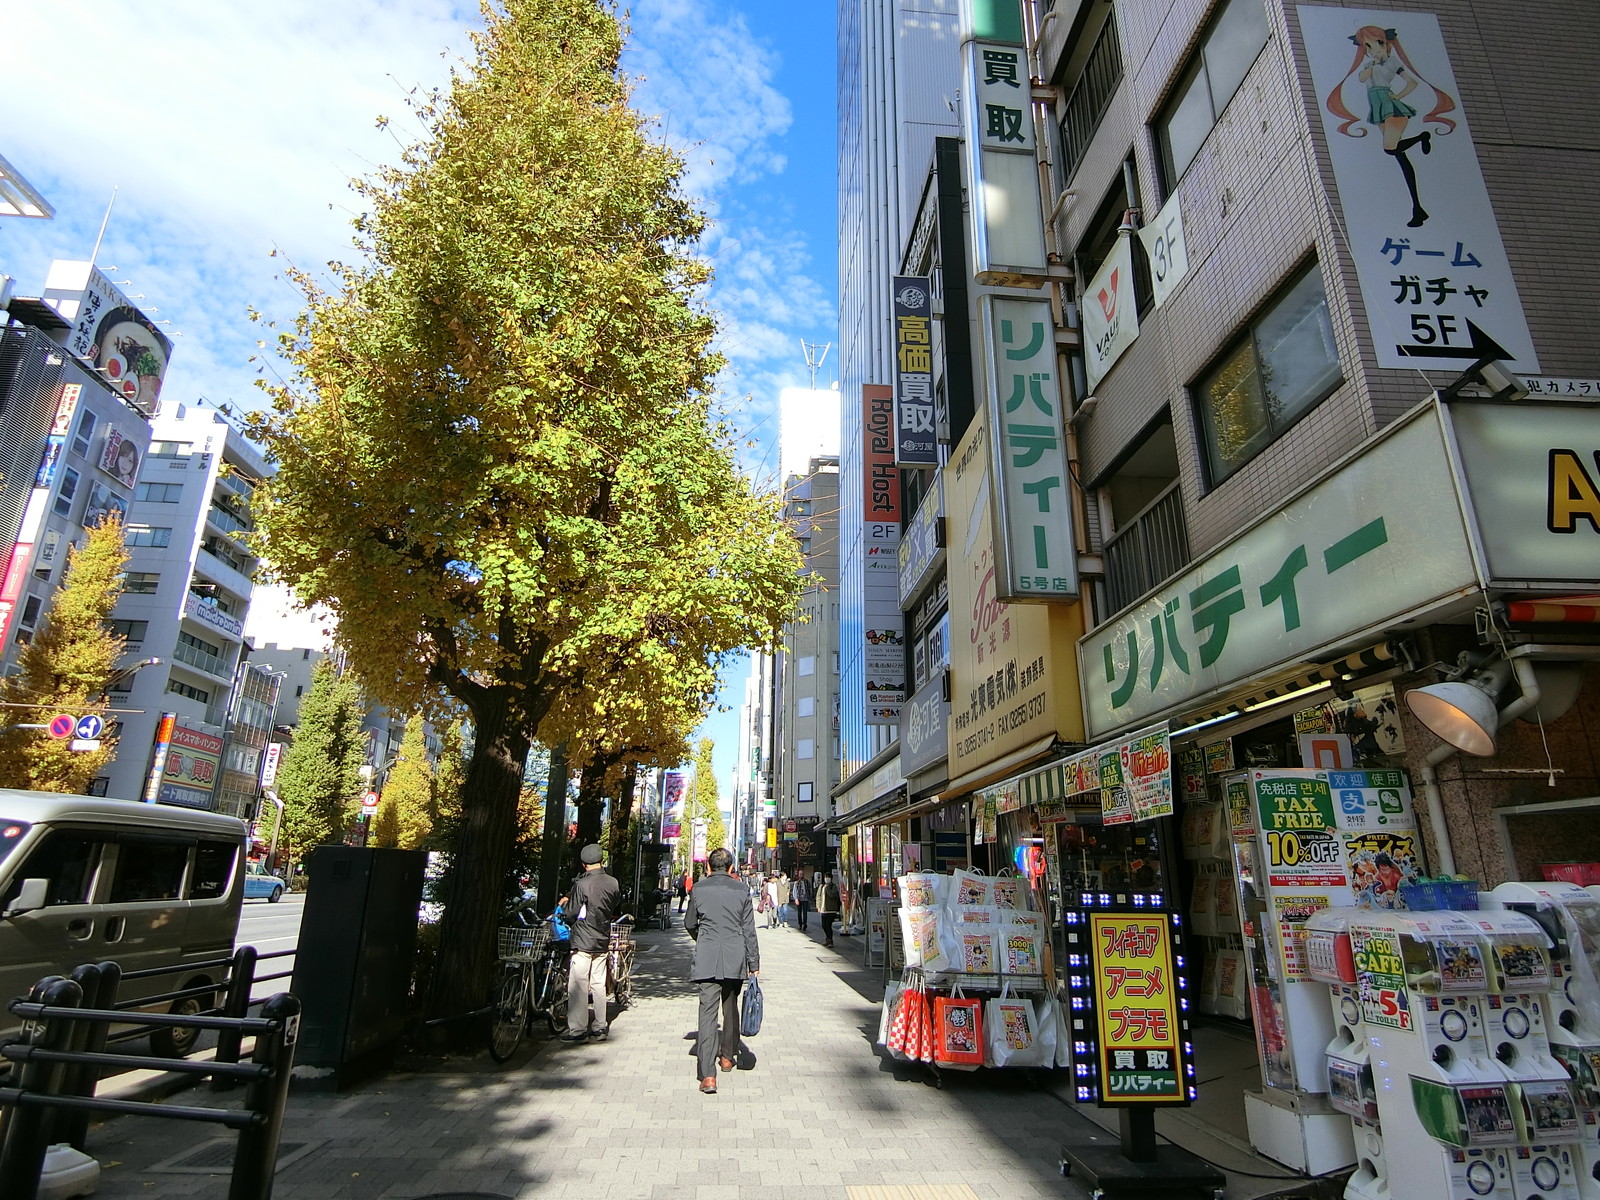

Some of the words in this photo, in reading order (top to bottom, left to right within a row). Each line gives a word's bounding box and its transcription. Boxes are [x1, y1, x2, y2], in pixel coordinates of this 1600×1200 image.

[983, 49, 1026, 143] 買取
[1154, 216, 1176, 283] 3F
[1380, 236, 1483, 268] ゲーム
[91, 272, 136, 321] HAKATA
[1391, 275, 1490, 308] ガチャ
[1410, 313, 1458, 345] 5F
[897, 315, 936, 434] 高価買取
[867, 397, 894, 455] Royal
[1001, 319, 1061, 570] リバティー
[872, 461, 896, 512] Host
[1548, 449, 1600, 534] A
[872, 524, 895, 538] 2F
[1020, 575, 1068, 592] 5号店
[197, 604, 242, 636] maidreamin
[1103, 516, 1389, 710] リバティー
[998, 713, 1010, 737] FAX
[1103, 764, 1117, 776] TAX
[1103, 774, 1120, 788] FREE
[1260, 783, 1297, 796] 免税店
[1274, 796, 1319, 812] TAX
[1300, 782, 1327, 796] 면세
[1272, 812, 1325, 828] FREE
[1267, 831, 1340, 866] 10%OFF
[1102, 924, 1160, 958] フィギュア
[1355, 952, 1403, 975] CAFE
[1105, 966, 1164, 999] アニメ
[1380, 990, 1398, 1016] 5
[1108, 1006, 1169, 1041] プラモ
[1375, 1015, 1399, 1026] TOILET
[1398, 1011, 1410, 1028] F
[1114, 1050, 1170, 1070] 買取
[1110, 1075, 1176, 1092] リバティー
